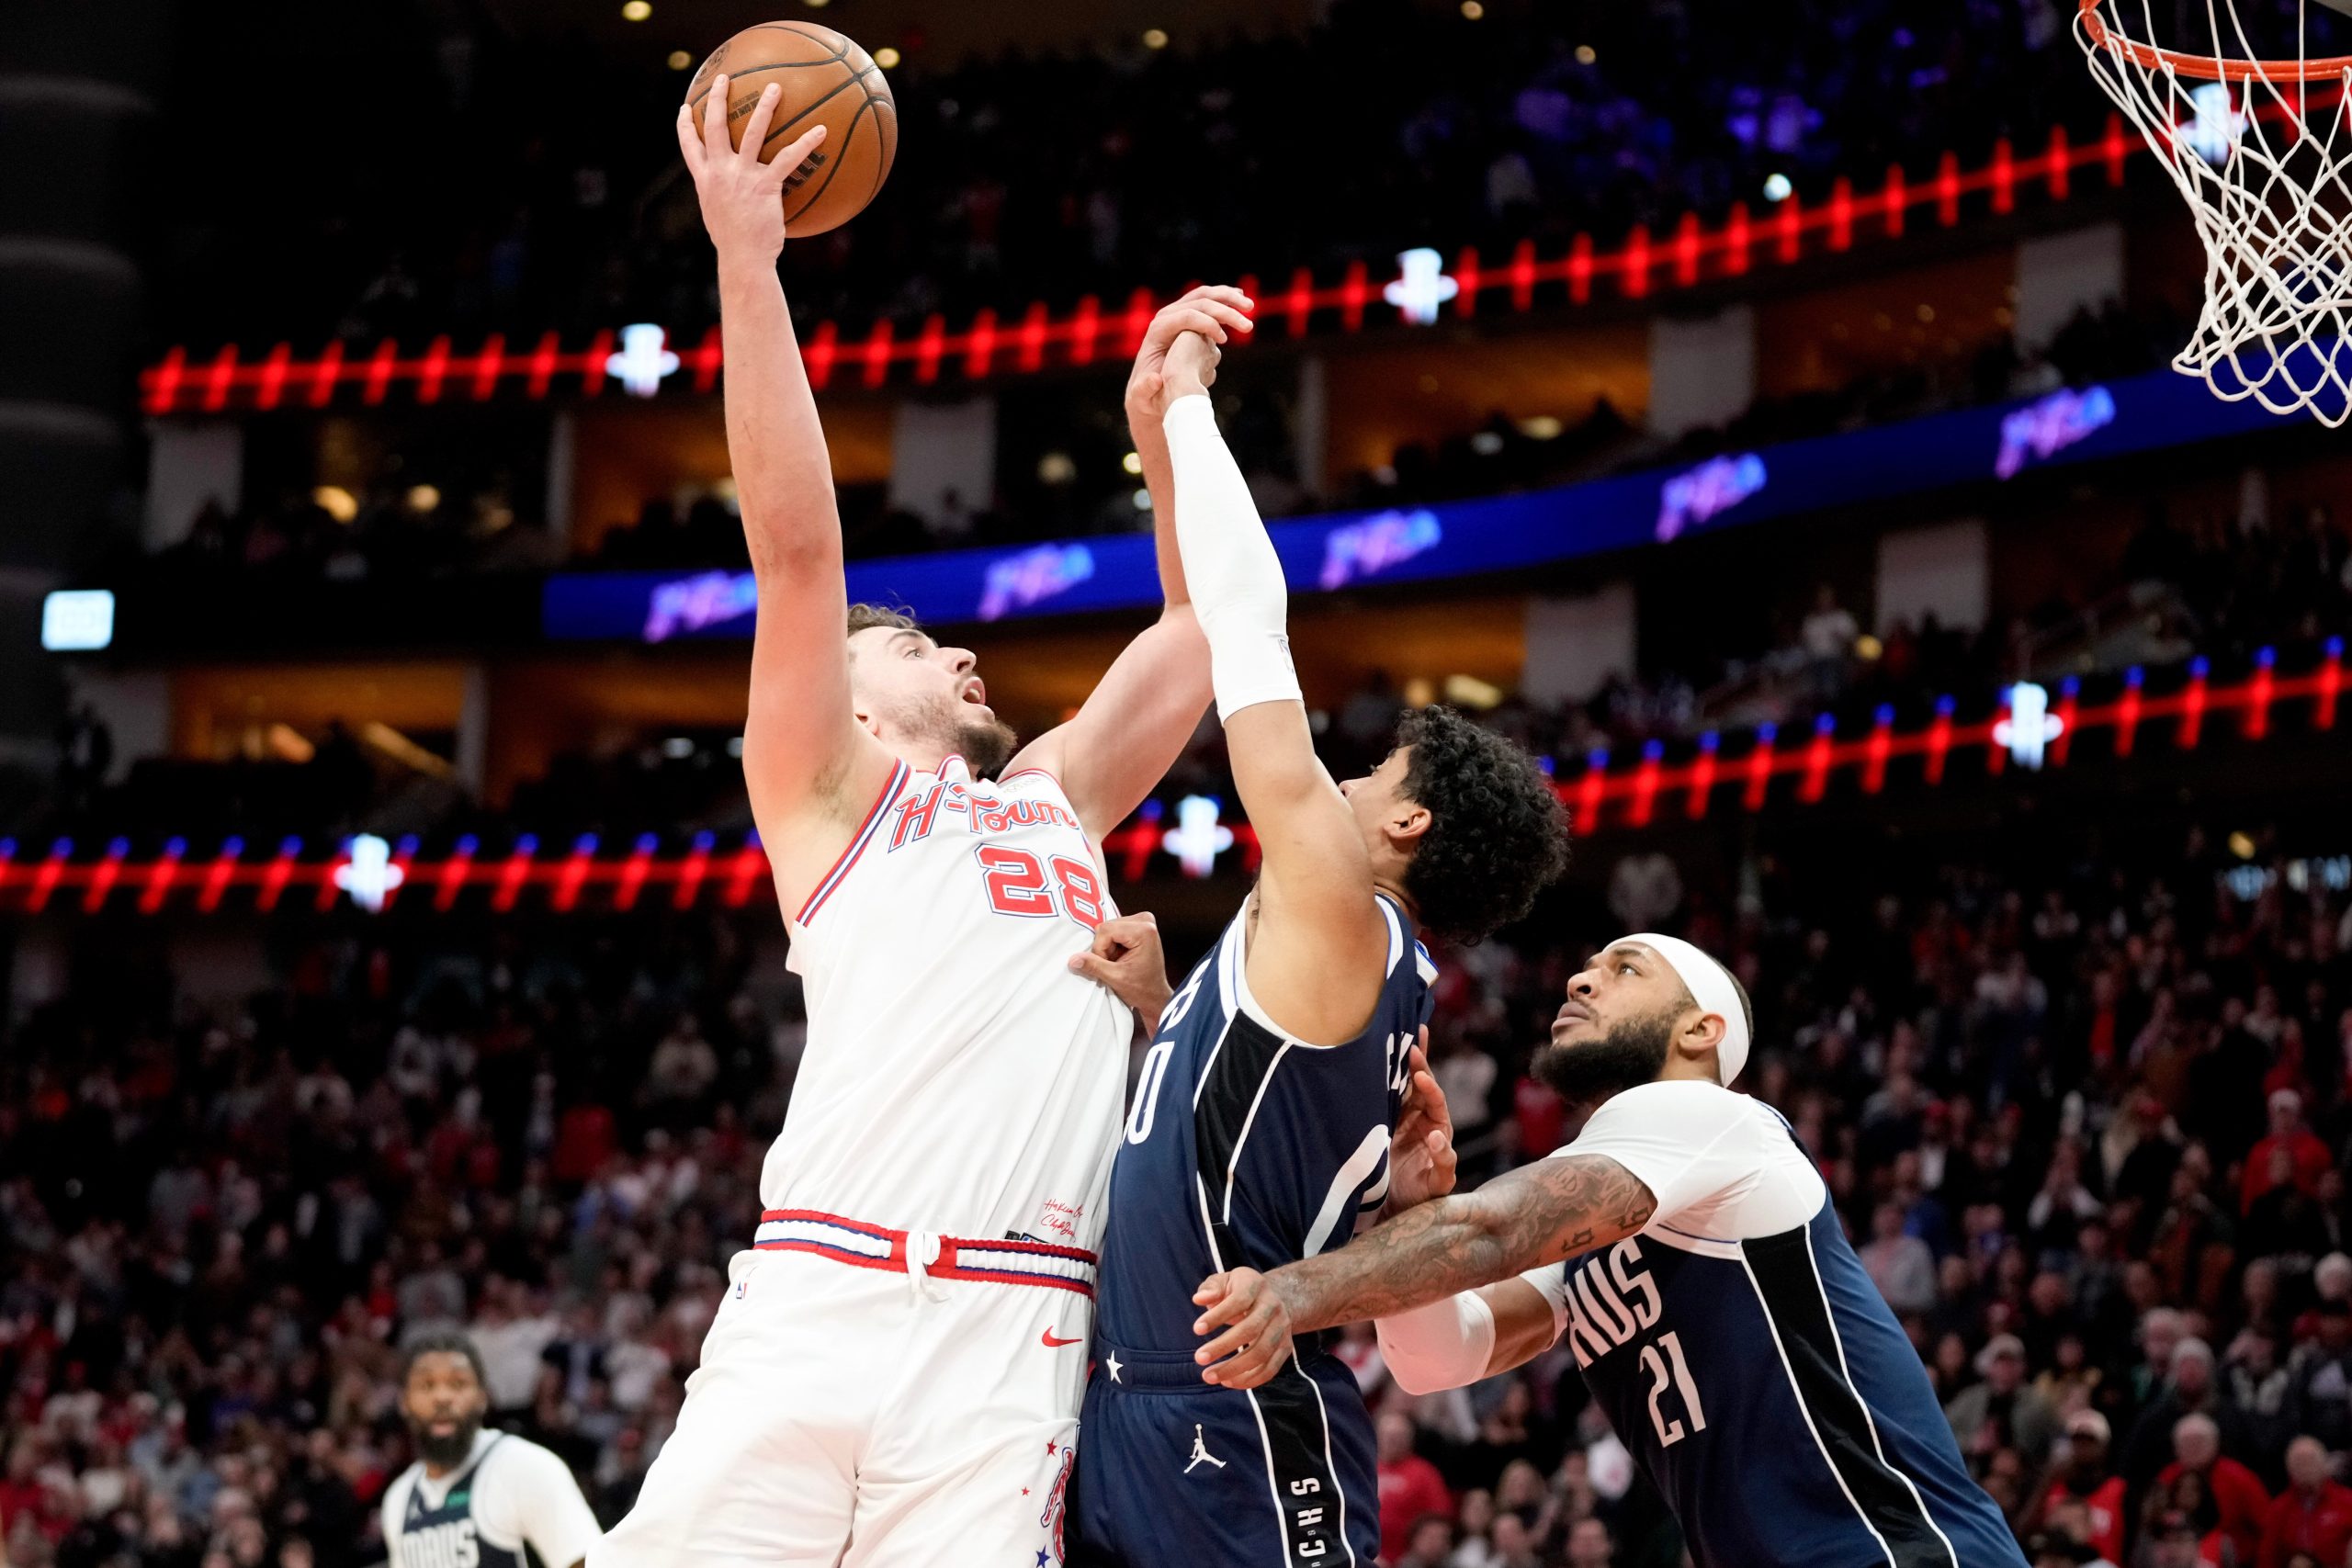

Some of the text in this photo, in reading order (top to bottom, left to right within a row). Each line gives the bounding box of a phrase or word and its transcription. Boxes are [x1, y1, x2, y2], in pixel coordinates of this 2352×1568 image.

[888, 781, 1080, 853] H-Town
[974, 842, 1106, 934] 28
[1120, 1040, 1175, 1147] 0
[1639, 1330, 1707, 1449] 21
